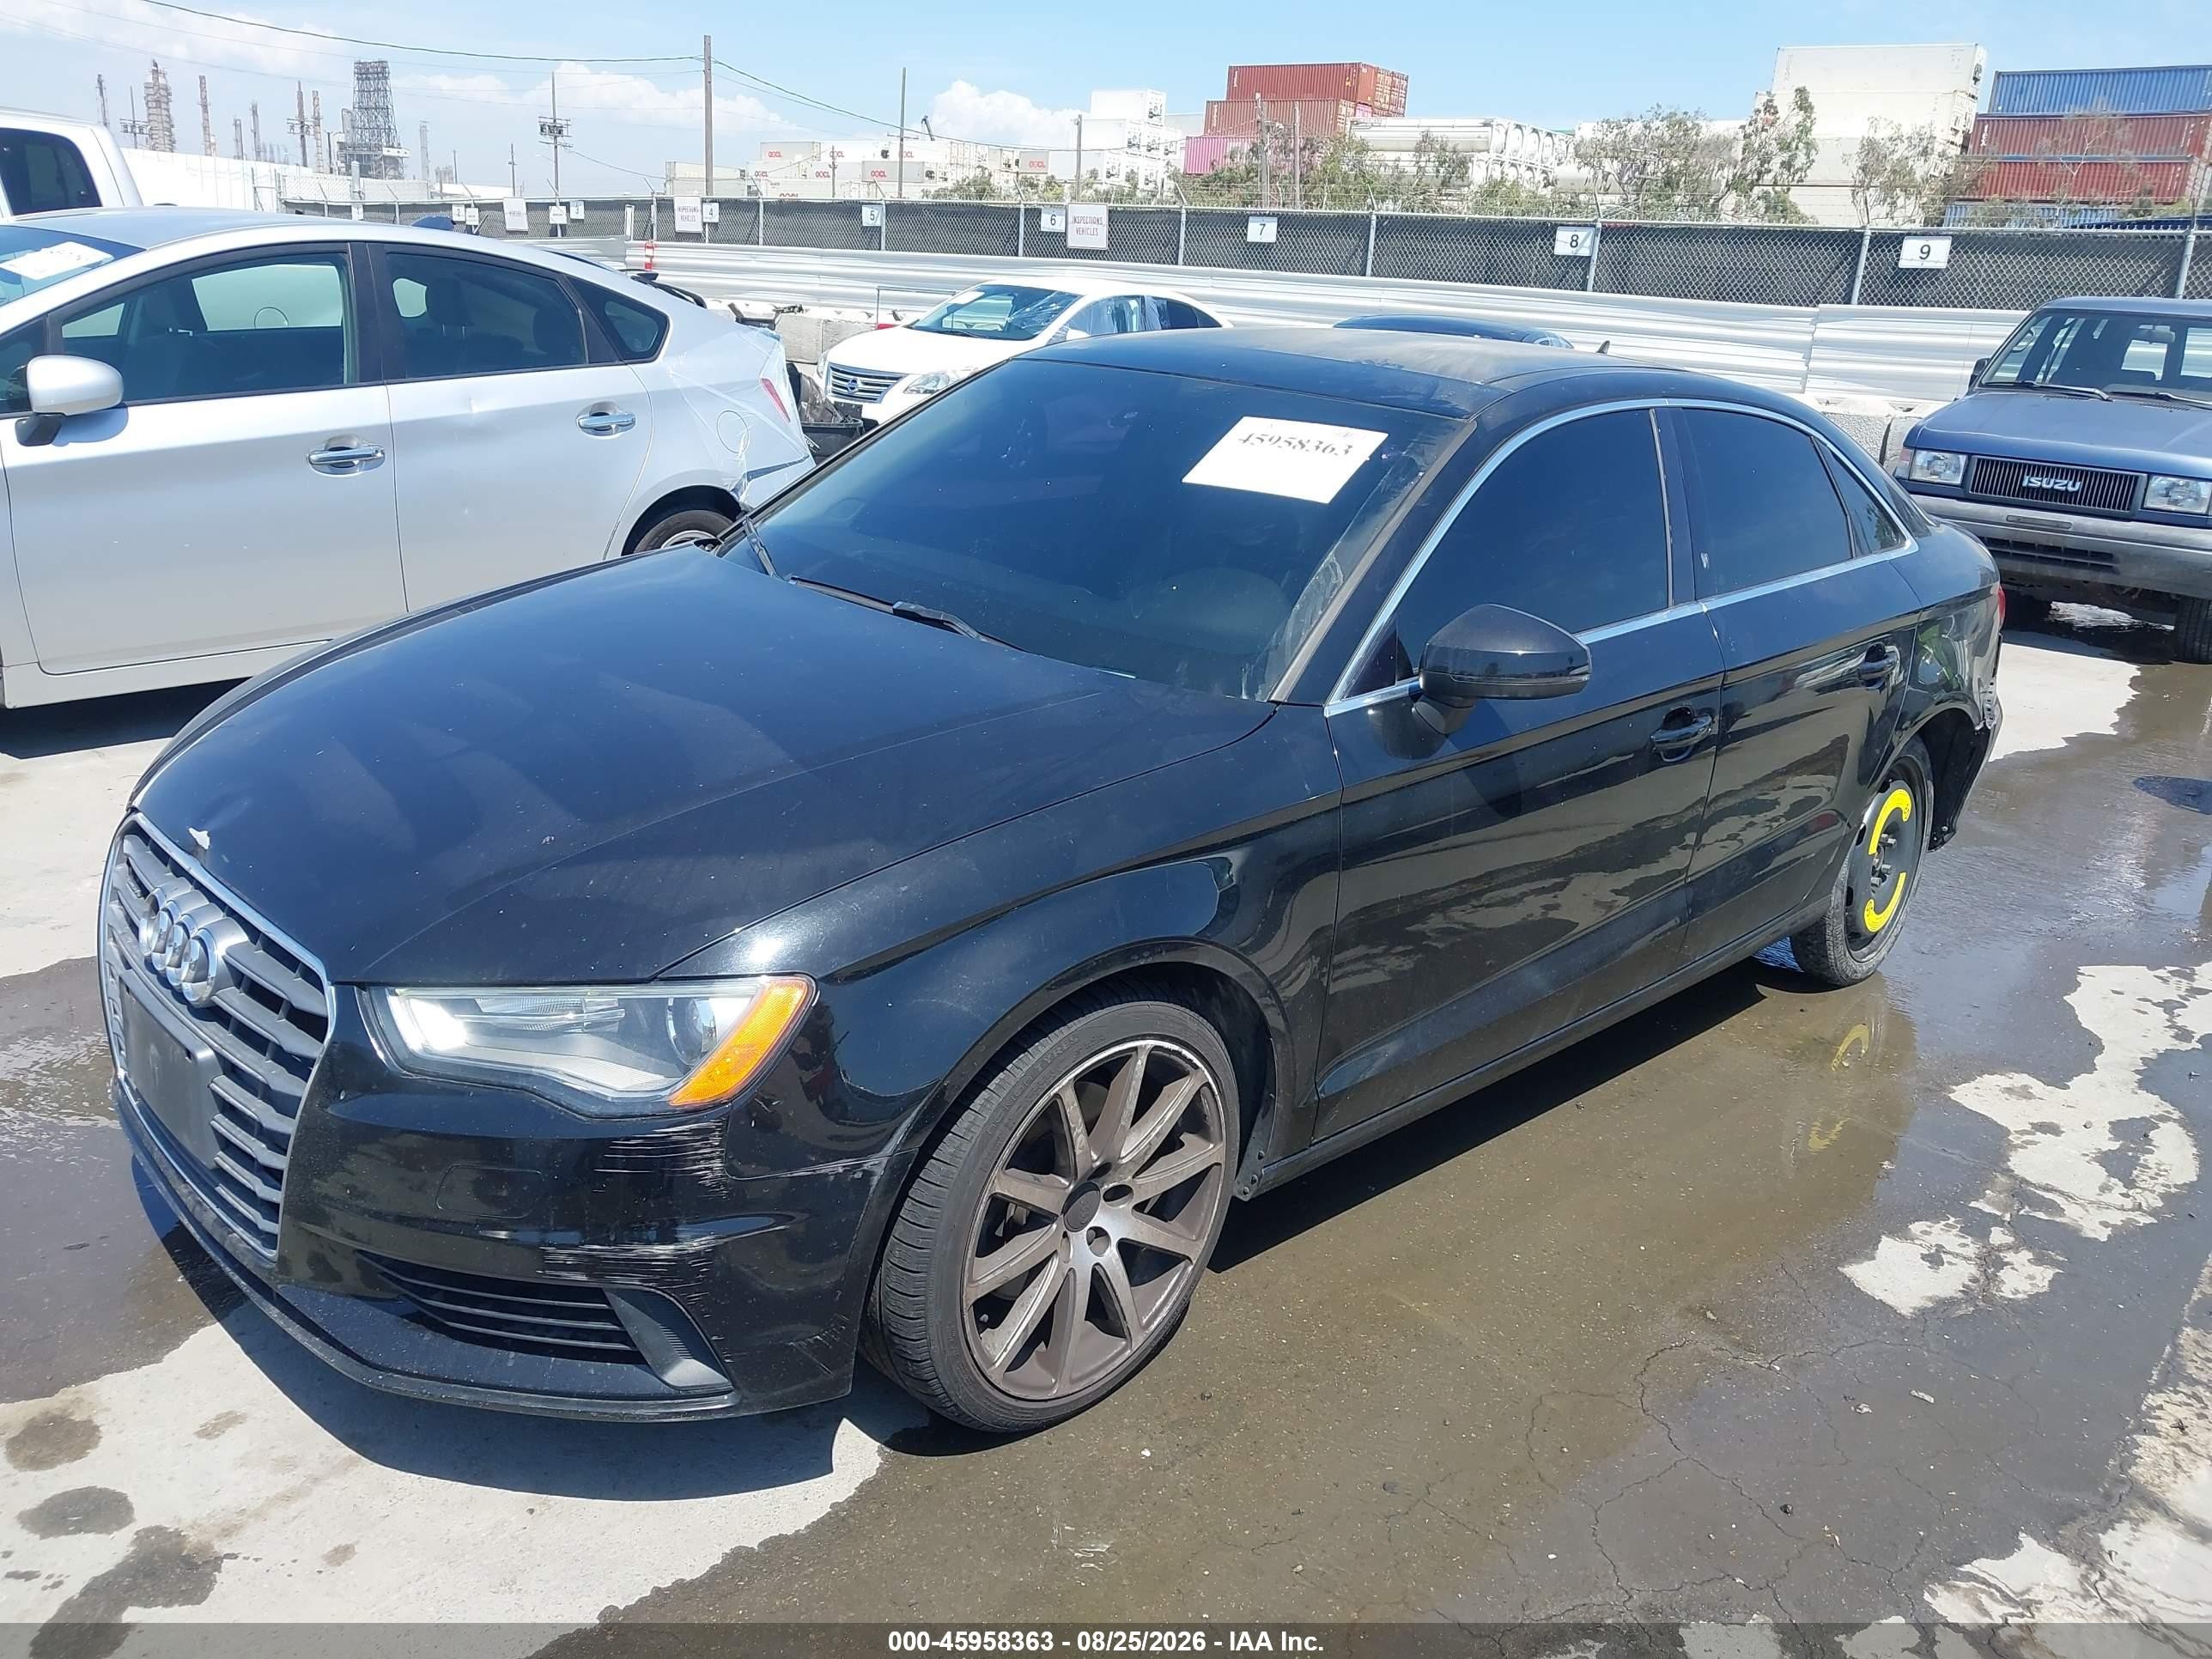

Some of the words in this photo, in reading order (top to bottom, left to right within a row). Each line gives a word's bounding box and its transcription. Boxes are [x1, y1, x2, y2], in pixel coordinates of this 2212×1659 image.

[869, 210, 875, 222] 5
[1050, 214, 1057, 226] 6
[1072, 215, 1103, 226] INSPECTIONS
[1075, 226, 1099, 236] VEHICLES
[1259, 223, 1267, 236] 7
[1570, 234, 1579, 248] 8
[1918, 244, 1931, 260] 9
[1237, 432, 1354, 456] 45958363
[2021, 475, 2082, 492] ISUZU
